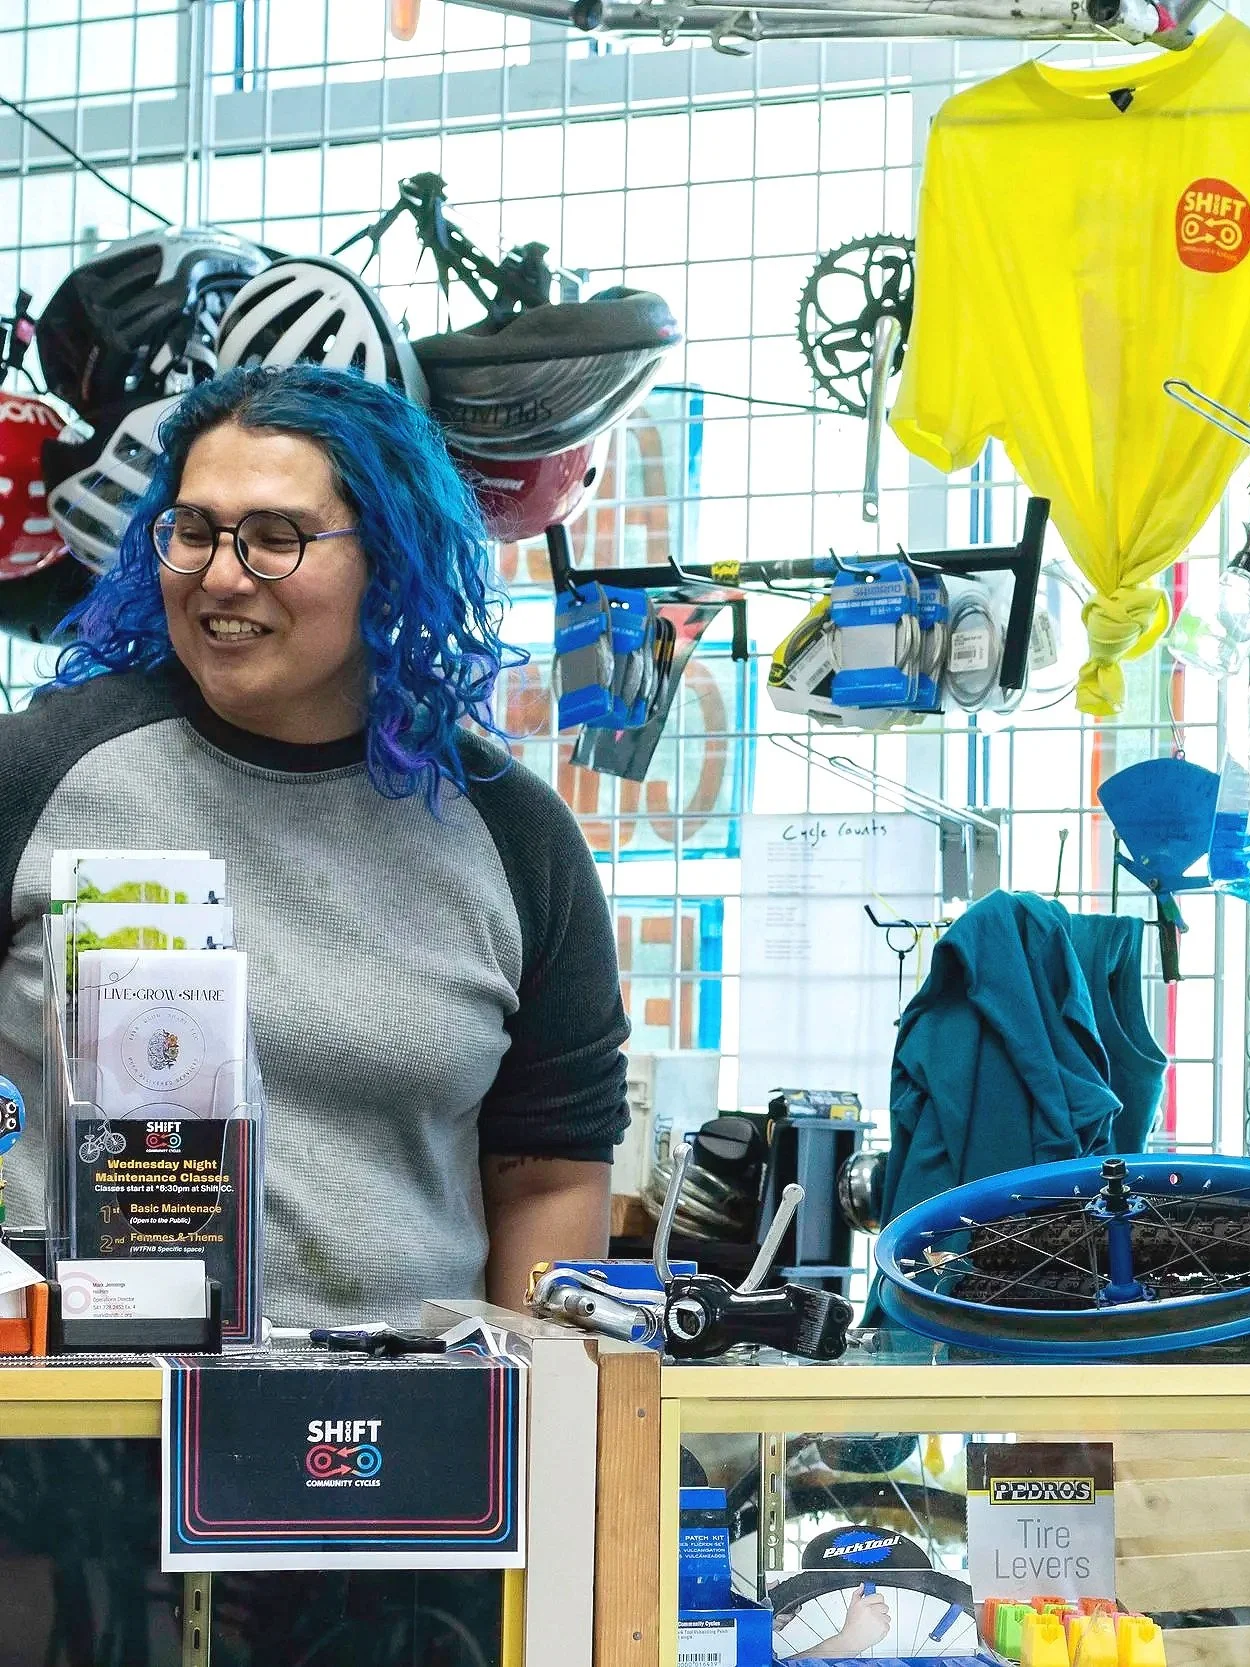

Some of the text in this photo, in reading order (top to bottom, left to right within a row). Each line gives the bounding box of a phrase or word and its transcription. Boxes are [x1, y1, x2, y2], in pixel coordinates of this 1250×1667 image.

[1183, 190, 1247, 221] SHIFT
[103, 988, 225, 1001] LIVE GROW SHARE
[146, 1121, 182, 1133] SHIFT
[107, 1159, 217, 1171] Wednesday Night
[95, 1172, 229, 1183] Maintenance Classes
[200, 1184, 219, 1192] Shift
[130, 1203, 159, 1213] Basic
[161, 1203, 222, 1213] Maintenace
[129, 1217, 149, 1225] (Open
[168, 1217, 191, 1225] Public)
[130, 1232, 174, 1242] Femmes
[188, 1232, 224, 1242] Thems
[157, 1246, 183, 1254] Specific
[183, 1246, 205, 1254] space)
[306, 1420, 382, 1443] SHIFT
[305, 1479, 381, 1487] COMMUNITY CYCLES
[1016, 1518, 1071, 1549] Tire
[995, 1549, 1090, 1580] Levers
